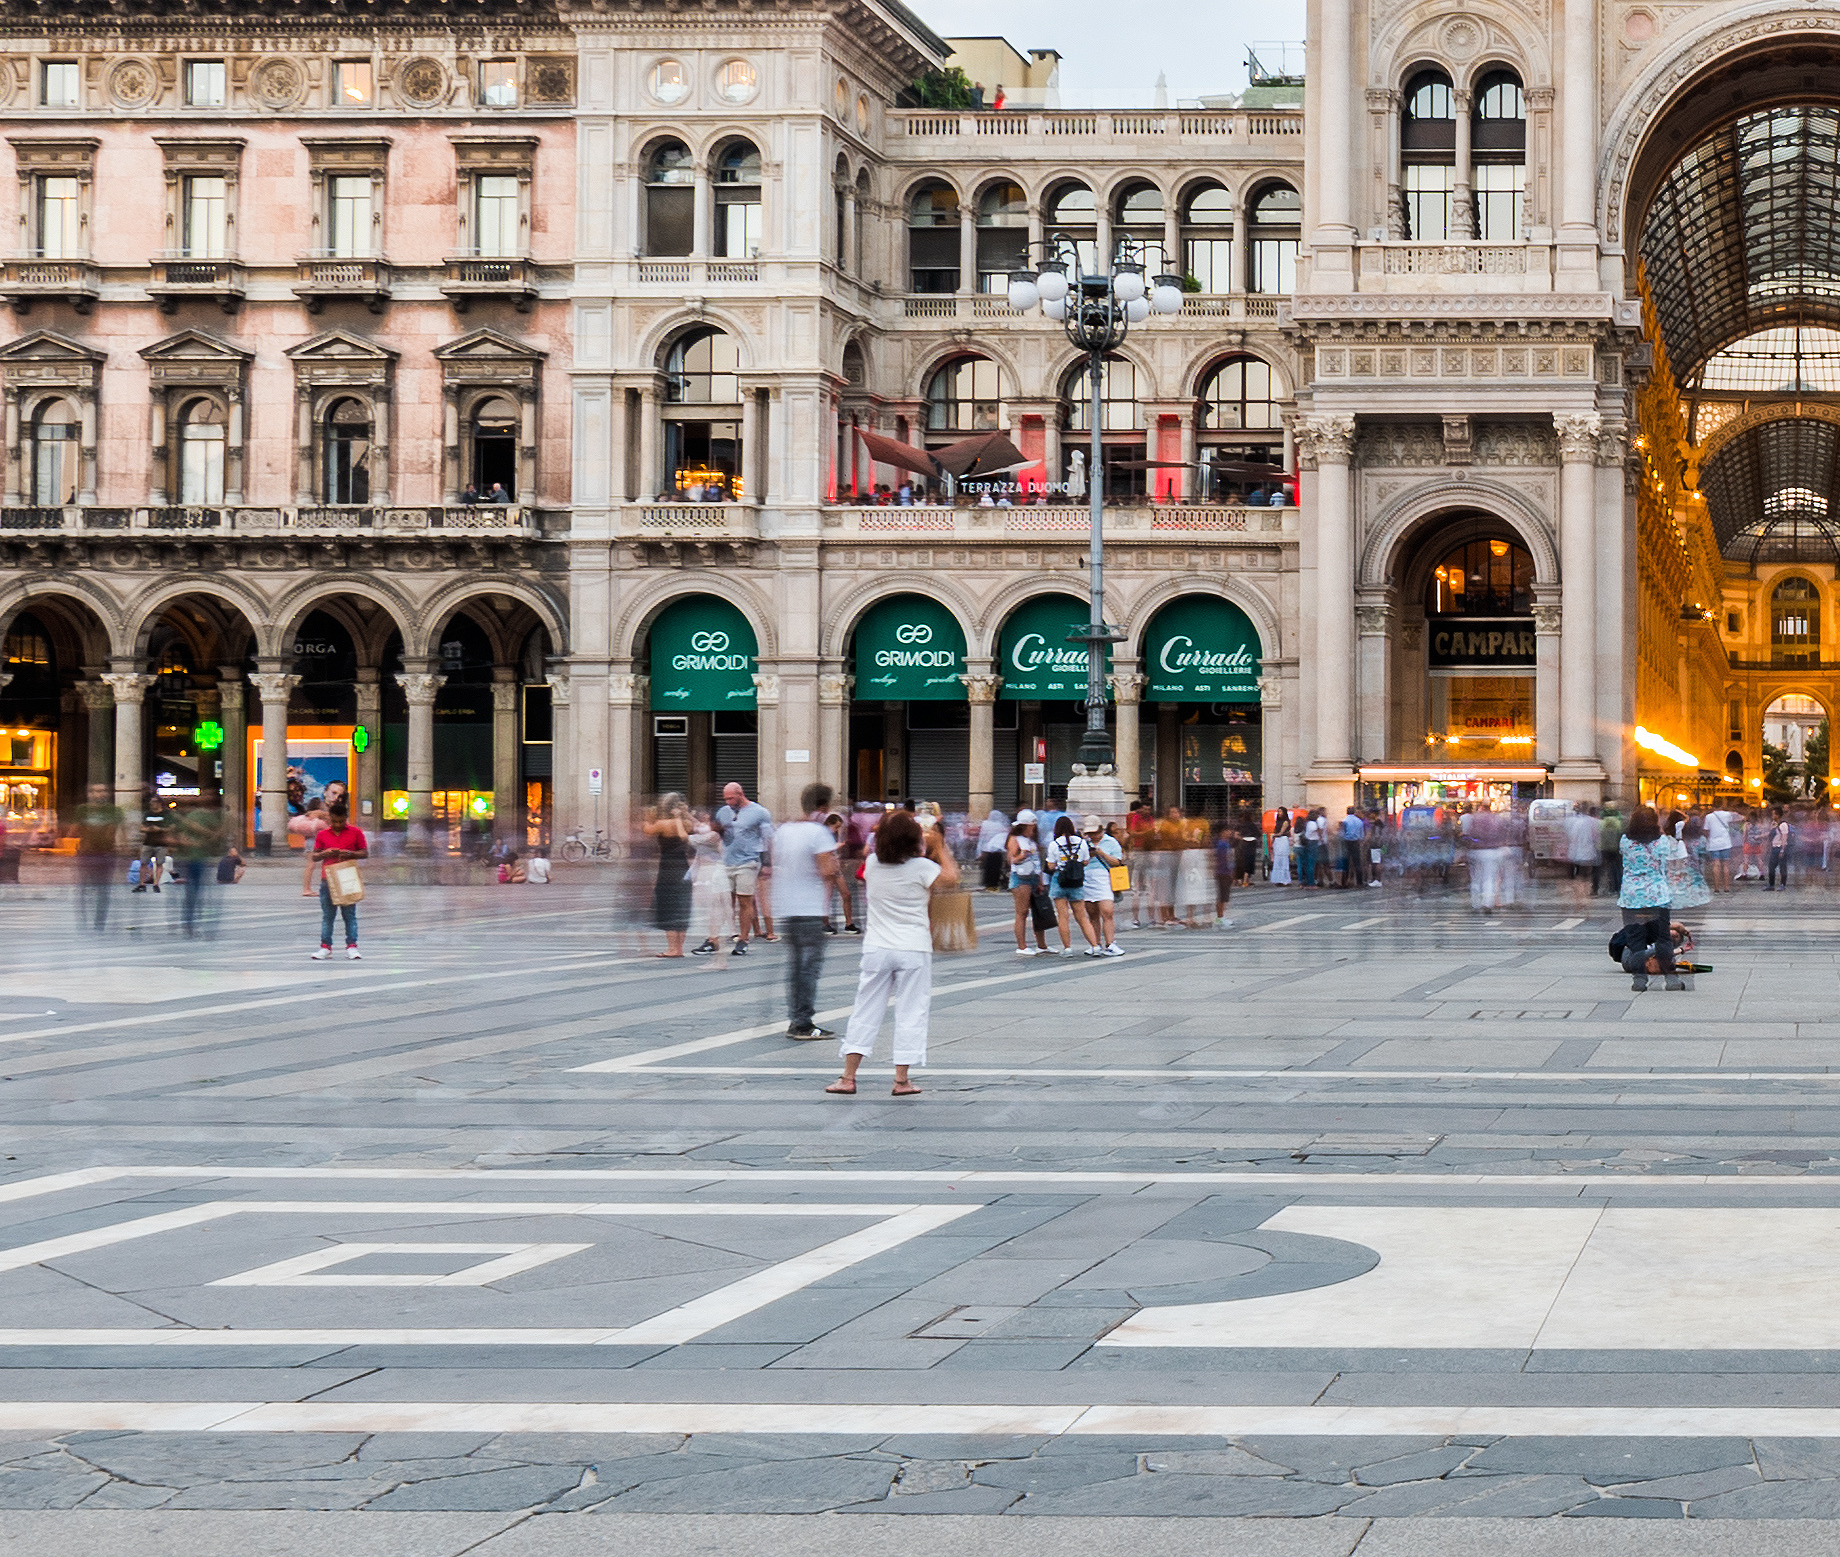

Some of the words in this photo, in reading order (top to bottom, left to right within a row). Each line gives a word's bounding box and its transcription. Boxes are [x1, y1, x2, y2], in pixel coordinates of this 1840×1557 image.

[961, 482, 1023, 494] TERRAZZA
[1028, 482, 1069, 494] DUOMO
[1435, 631, 1535, 656] CAMPAR
[875, 650, 955, 667] GRIMOLDI
[1012, 633, 1090, 672] Curra
[1160, 635, 1253, 674] Currado
[672, 654, 748, 671] GRIMOLDI
[1198, 666, 1253, 675] GIOIELLERIE
